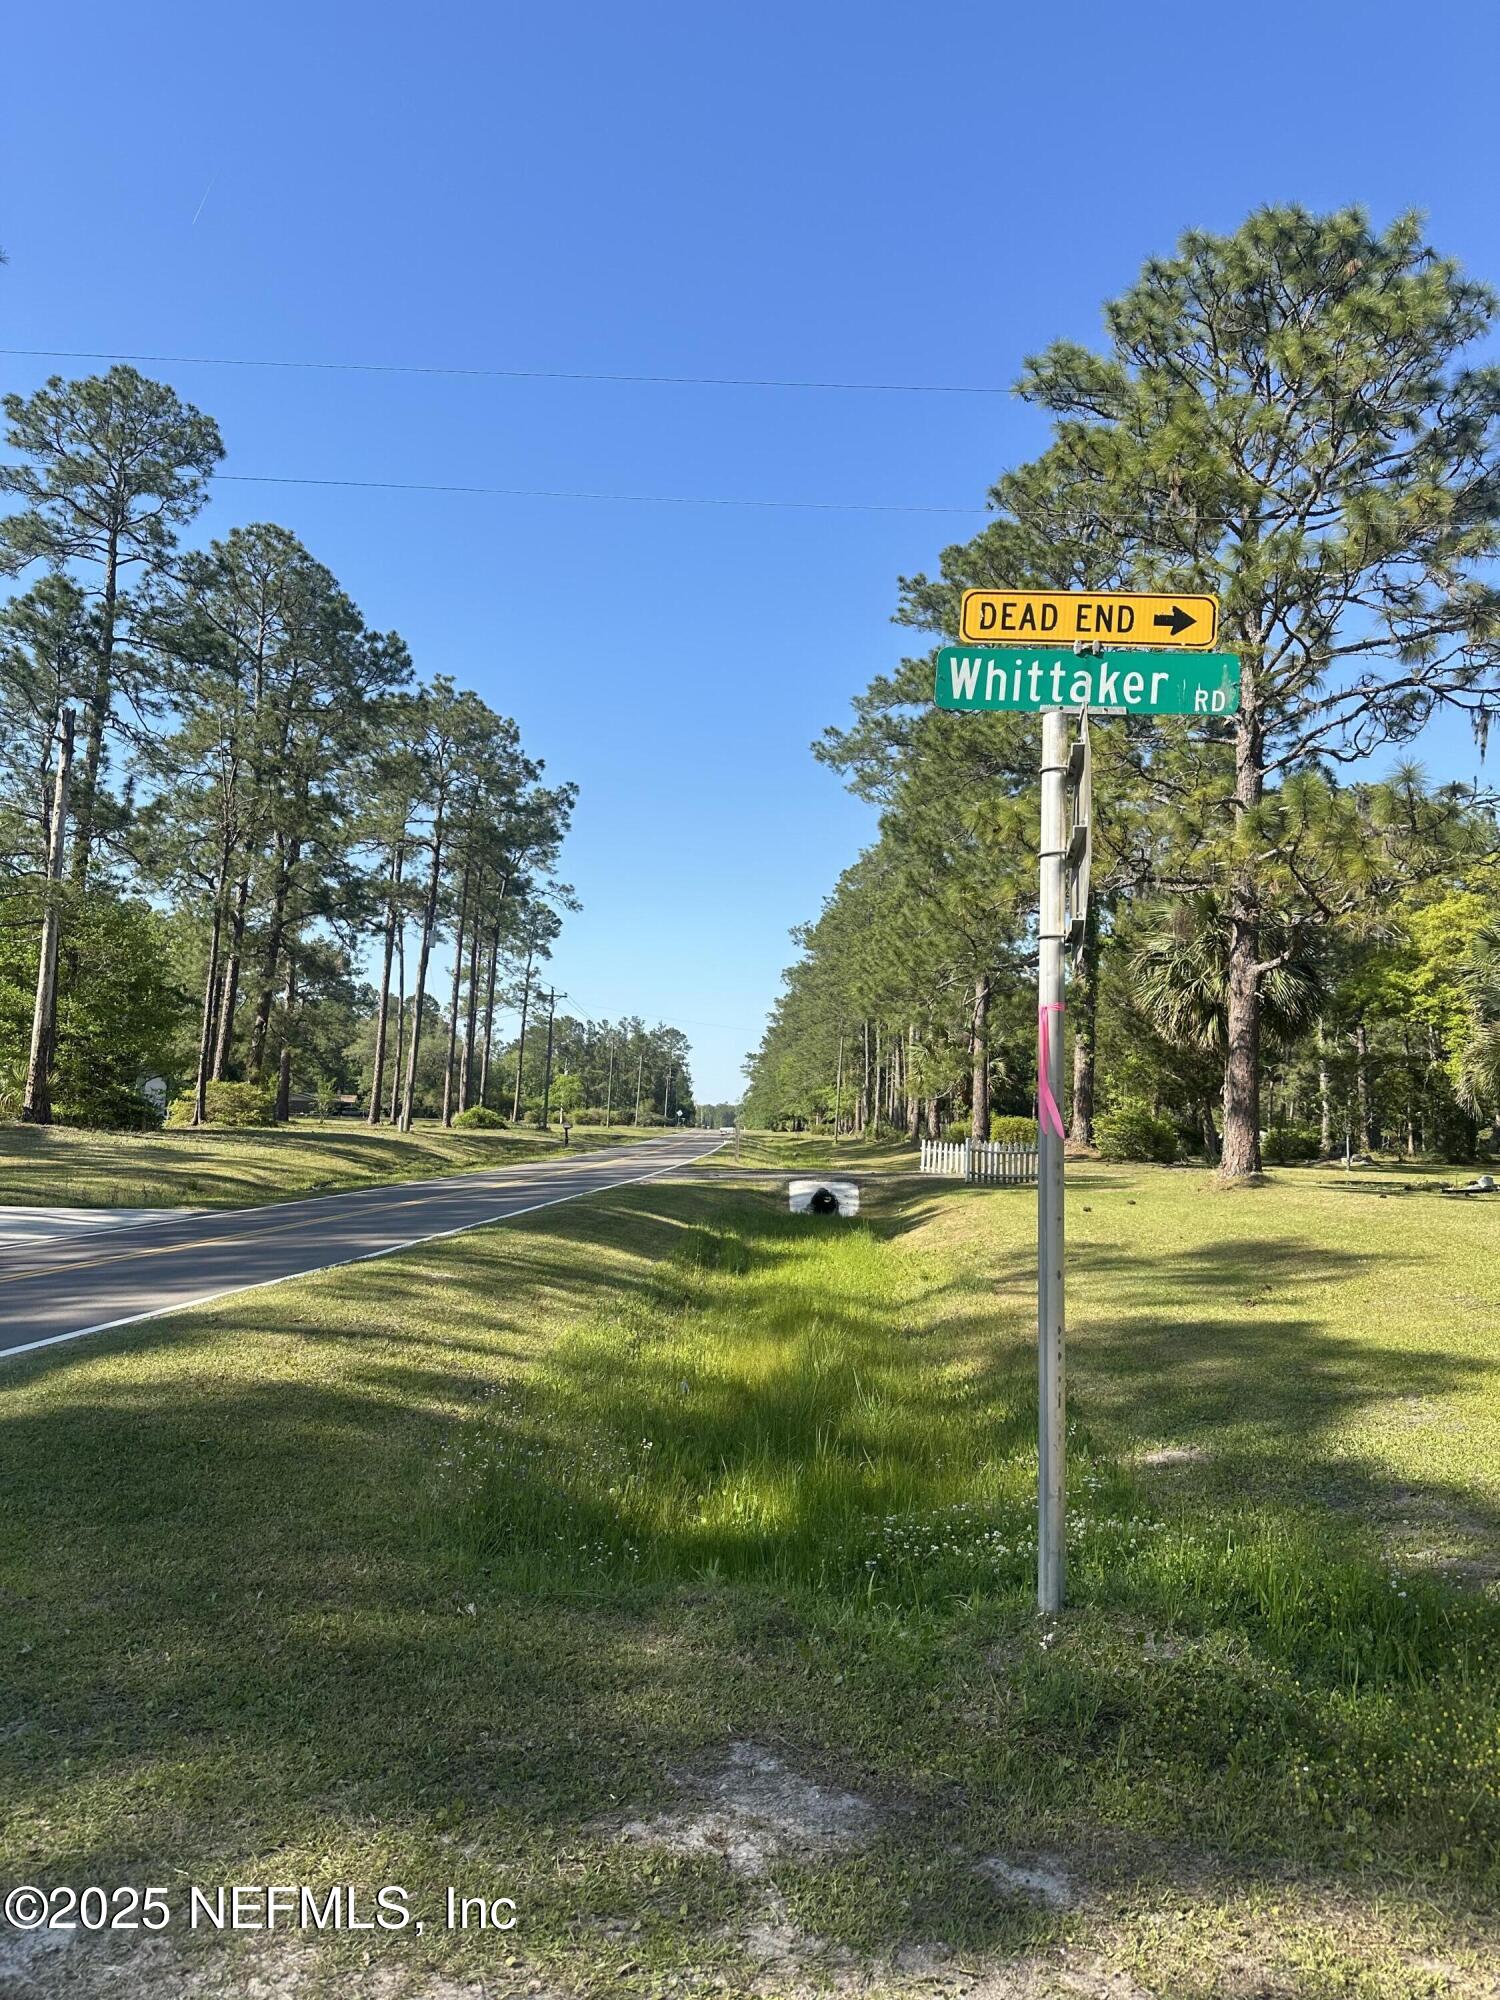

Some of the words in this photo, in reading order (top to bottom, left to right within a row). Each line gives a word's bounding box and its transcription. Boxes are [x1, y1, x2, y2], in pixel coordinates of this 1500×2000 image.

[979, 602, 1058, 631] DEAD
[1075, 604, 1135, 633] END
[949, 657, 1169, 706] Whittaker
[1194, 689, 1226, 713] RD
